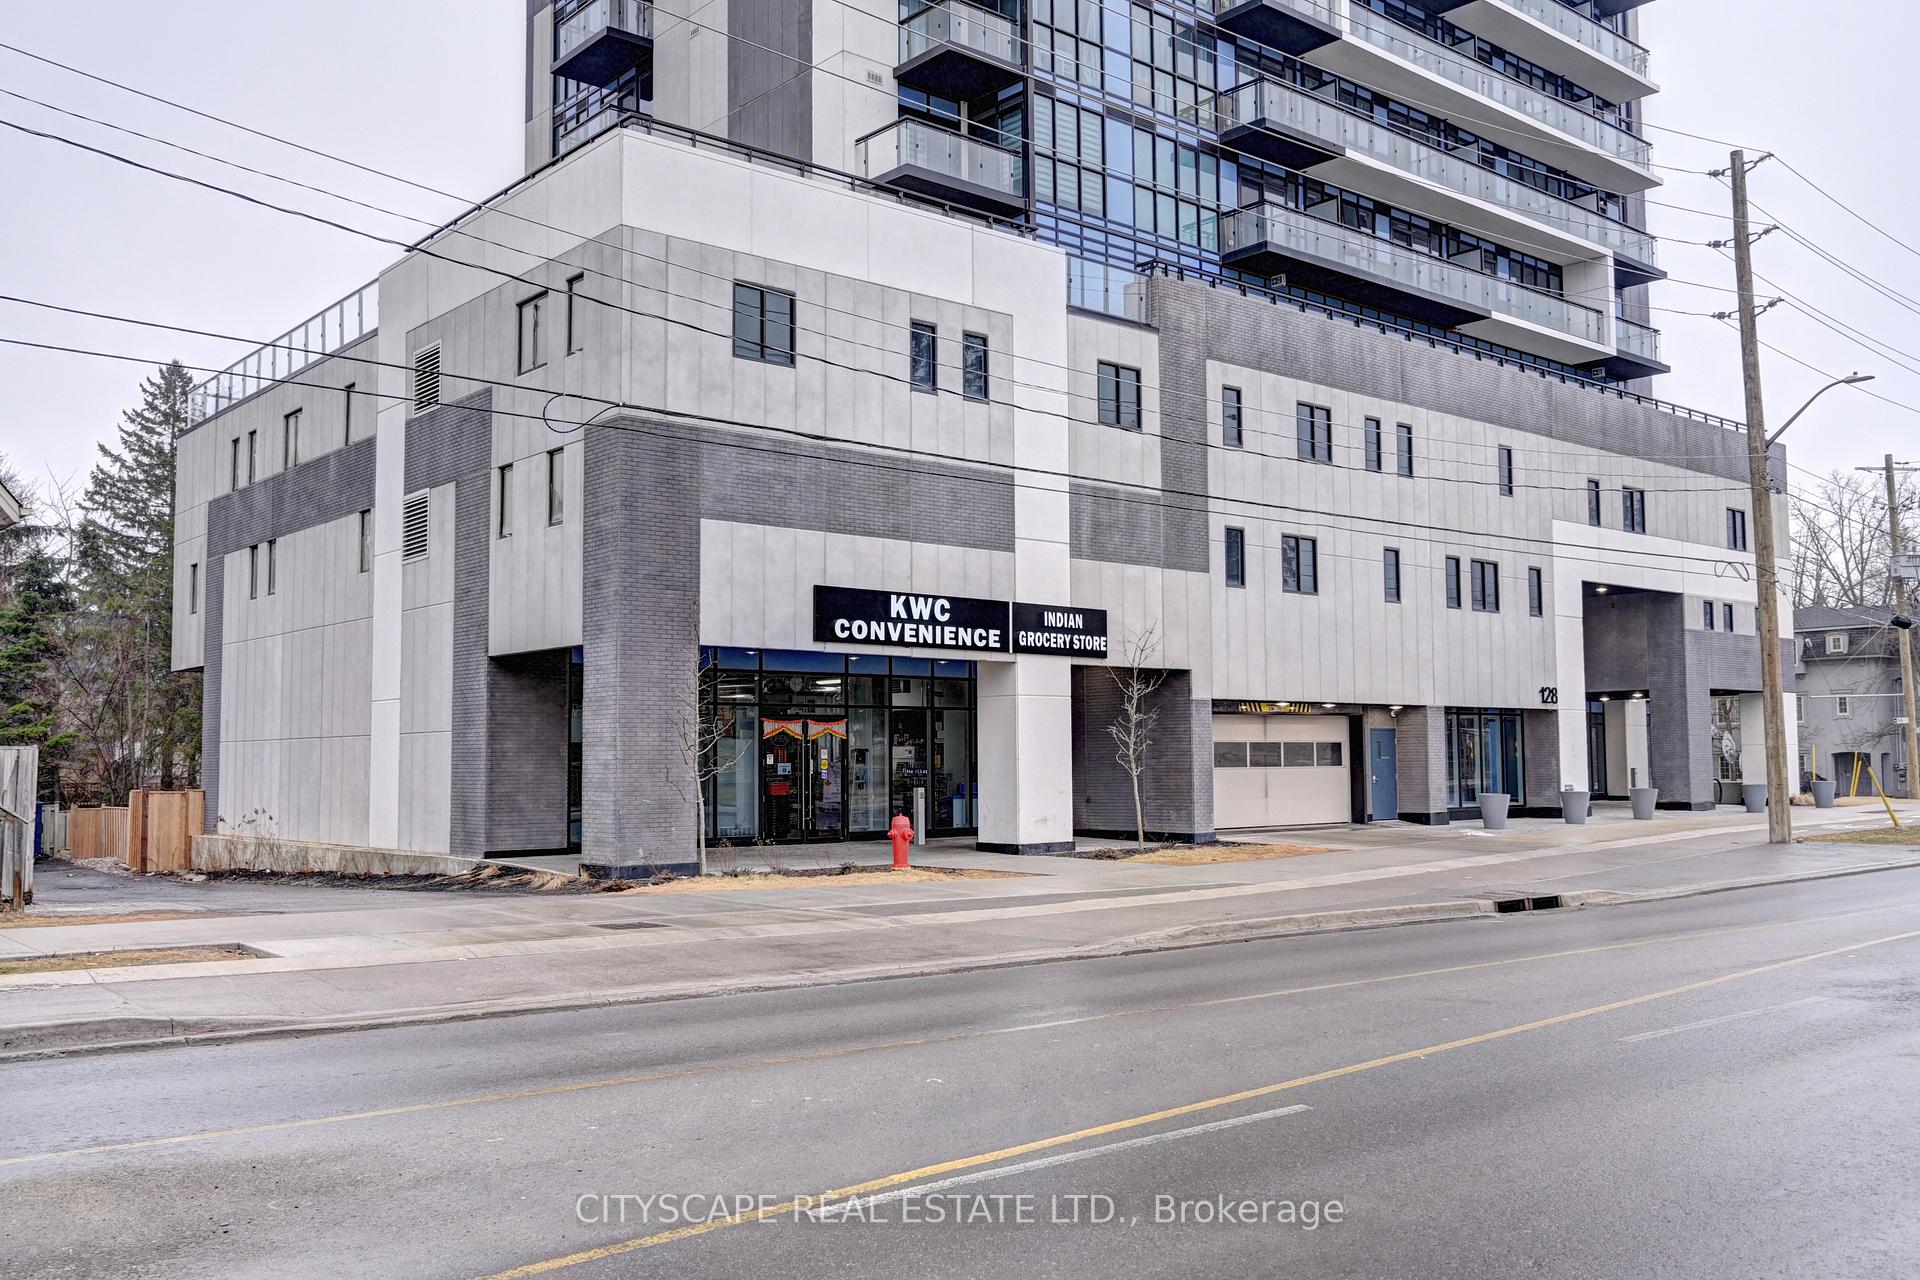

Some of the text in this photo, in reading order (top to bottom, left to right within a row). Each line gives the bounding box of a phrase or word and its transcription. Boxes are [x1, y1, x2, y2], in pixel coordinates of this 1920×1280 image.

[890, 594, 951, 622] KWC
[1044, 610, 1084, 629] INDIAN
[834, 618, 1001, 648] CONVENIENCE
[1018, 630, 1107, 651] GROCERY STORE
[1539, 686, 1558, 704] 128
